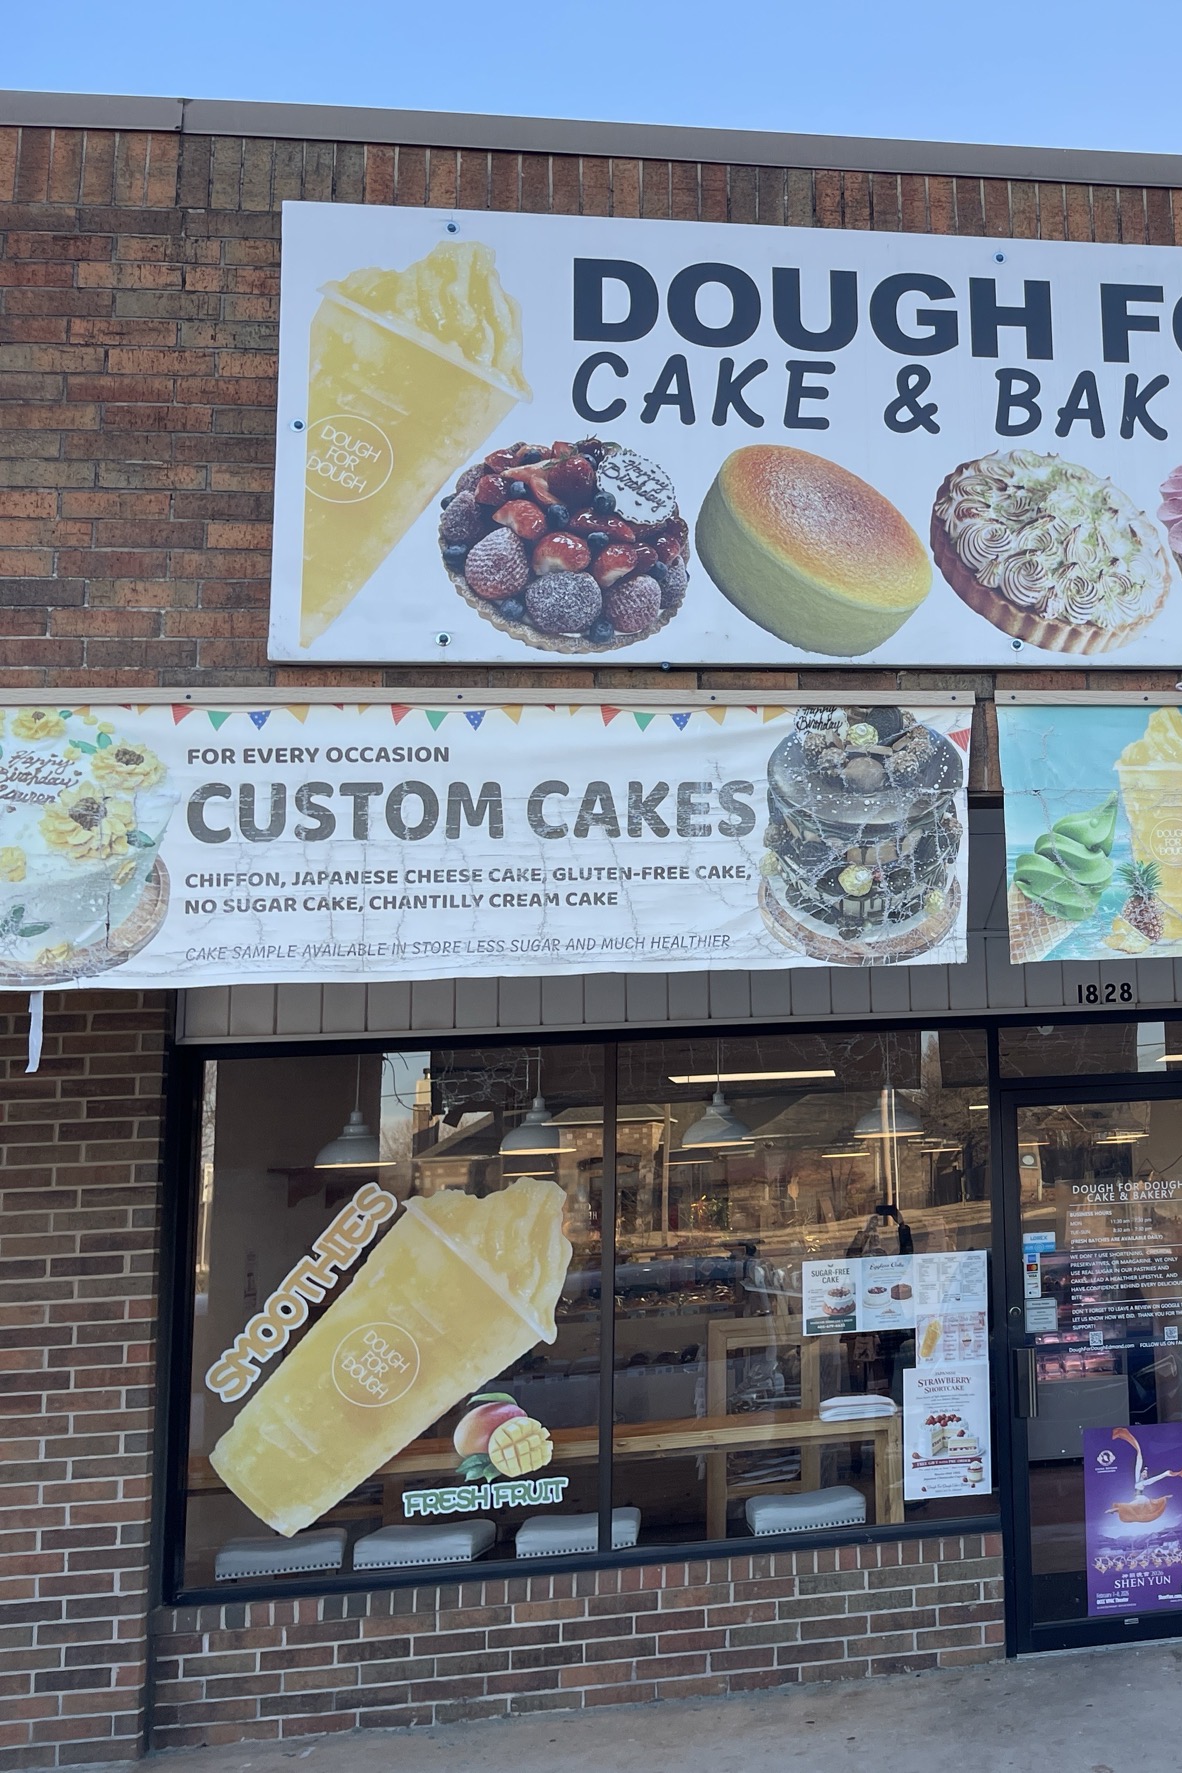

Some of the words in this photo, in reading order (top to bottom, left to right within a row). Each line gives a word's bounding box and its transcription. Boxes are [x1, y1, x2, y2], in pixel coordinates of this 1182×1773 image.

[572, 257, 1054, 360] DOUGH
[570, 351, 836, 430] CAKE
[884, 364, 940, 435] &
[320, 425, 381, 463] DOUGH
[325, 446, 360, 471] FOR
[306, 456, 367, 493] DOUGH
[187, 747, 236, 765] FOR
[242, 747, 320, 764] EVERY
[325, 746, 450, 764] OCCASION
[186, 780, 505, 844] CUSTOM
[527, 780, 757, 840] CAKES
[185, 871, 287, 889] CHIFFON,
[291, 869, 400, 887] JAPANESE
[403, 868, 484, 885] CHEESE
[488, 867, 548, 884] CAKE,
[553, 865, 690, 882] GLUTEN-FREE
[694, 864, 752, 881] CAKE,
[184, 898, 217, 915] NO
[223, 897, 297, 914] SUGAR
[303, 896, 364, 913] CAKE,
[368, 894, 485, 911] CHANTILLY
[489, 893, 560, 909] CREAM
[565, 891, 618, 907] CAKE
[185, 945, 227, 962] CAKE
[232, 943, 299, 961] SAMPLE
[302, 942, 388, 958] AVAILABLE
[391, 941, 407, 957] IN
[412, 940, 463, 957] STORE
[467, 939, 506, 954] LESS
[510, 938, 560, 953] SUGAR
[566, 937, 596, 951] AND
[600, 936, 646, 950] MUCH
[650, 934, 730, 950] HEALTHIER
[1077, 982, 1133, 1004] 1828
[1072, 1183, 1114, 1194] DOUGH
[1118, 1181, 1139, 1192] FOR
[1086, 1192, 1115, 1202] CAKE
[1119, 1192, 1128, 1201] &
[1133, 1189, 1175, 1200] BAKERY
[811, 1267, 850, 1277] SUGAR-FREE
[821, 1276, 839, 1284] CAKE
[207, 1182, 398, 1402] SMOOTHIES
[360, 1350, 389, 1378] FOR
[363, 1329, 410, 1373] DOUGH
[341, 1356, 388, 1399] DOUGH
[402, 1484, 491, 1517] FRESH
[492, 1477, 569, 1509] FRUIT
[1114, 1577, 1145, 1589] SHEN
[1147, 1575, 1171, 1586] YUN
